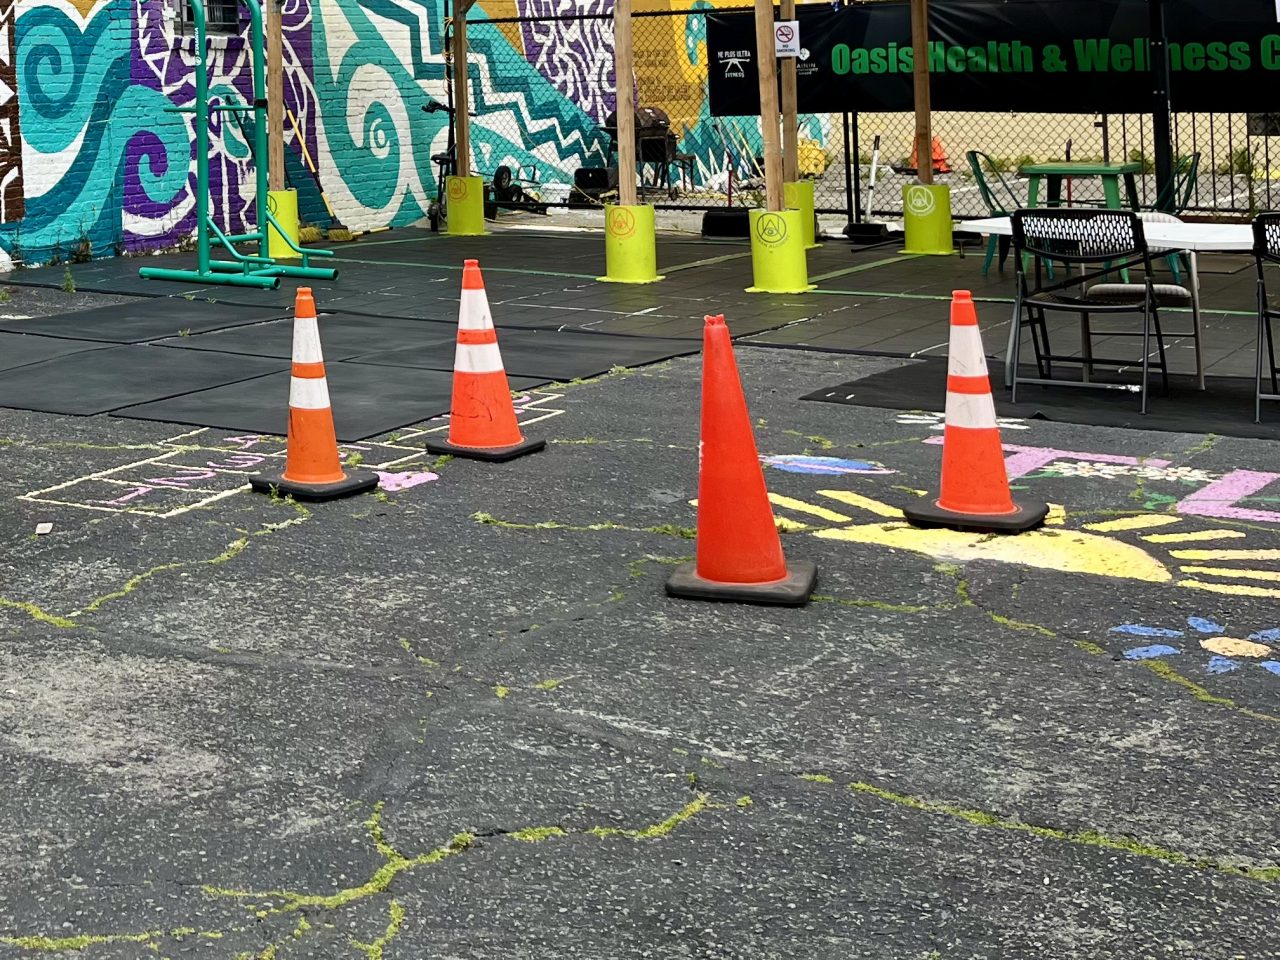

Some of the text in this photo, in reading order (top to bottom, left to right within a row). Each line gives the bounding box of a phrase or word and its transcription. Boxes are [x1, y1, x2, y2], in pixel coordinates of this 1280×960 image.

[831, 42, 914, 75] Oasis
[927, 40, 1034, 73] Health
[1042, 44, 1067, 72] &
